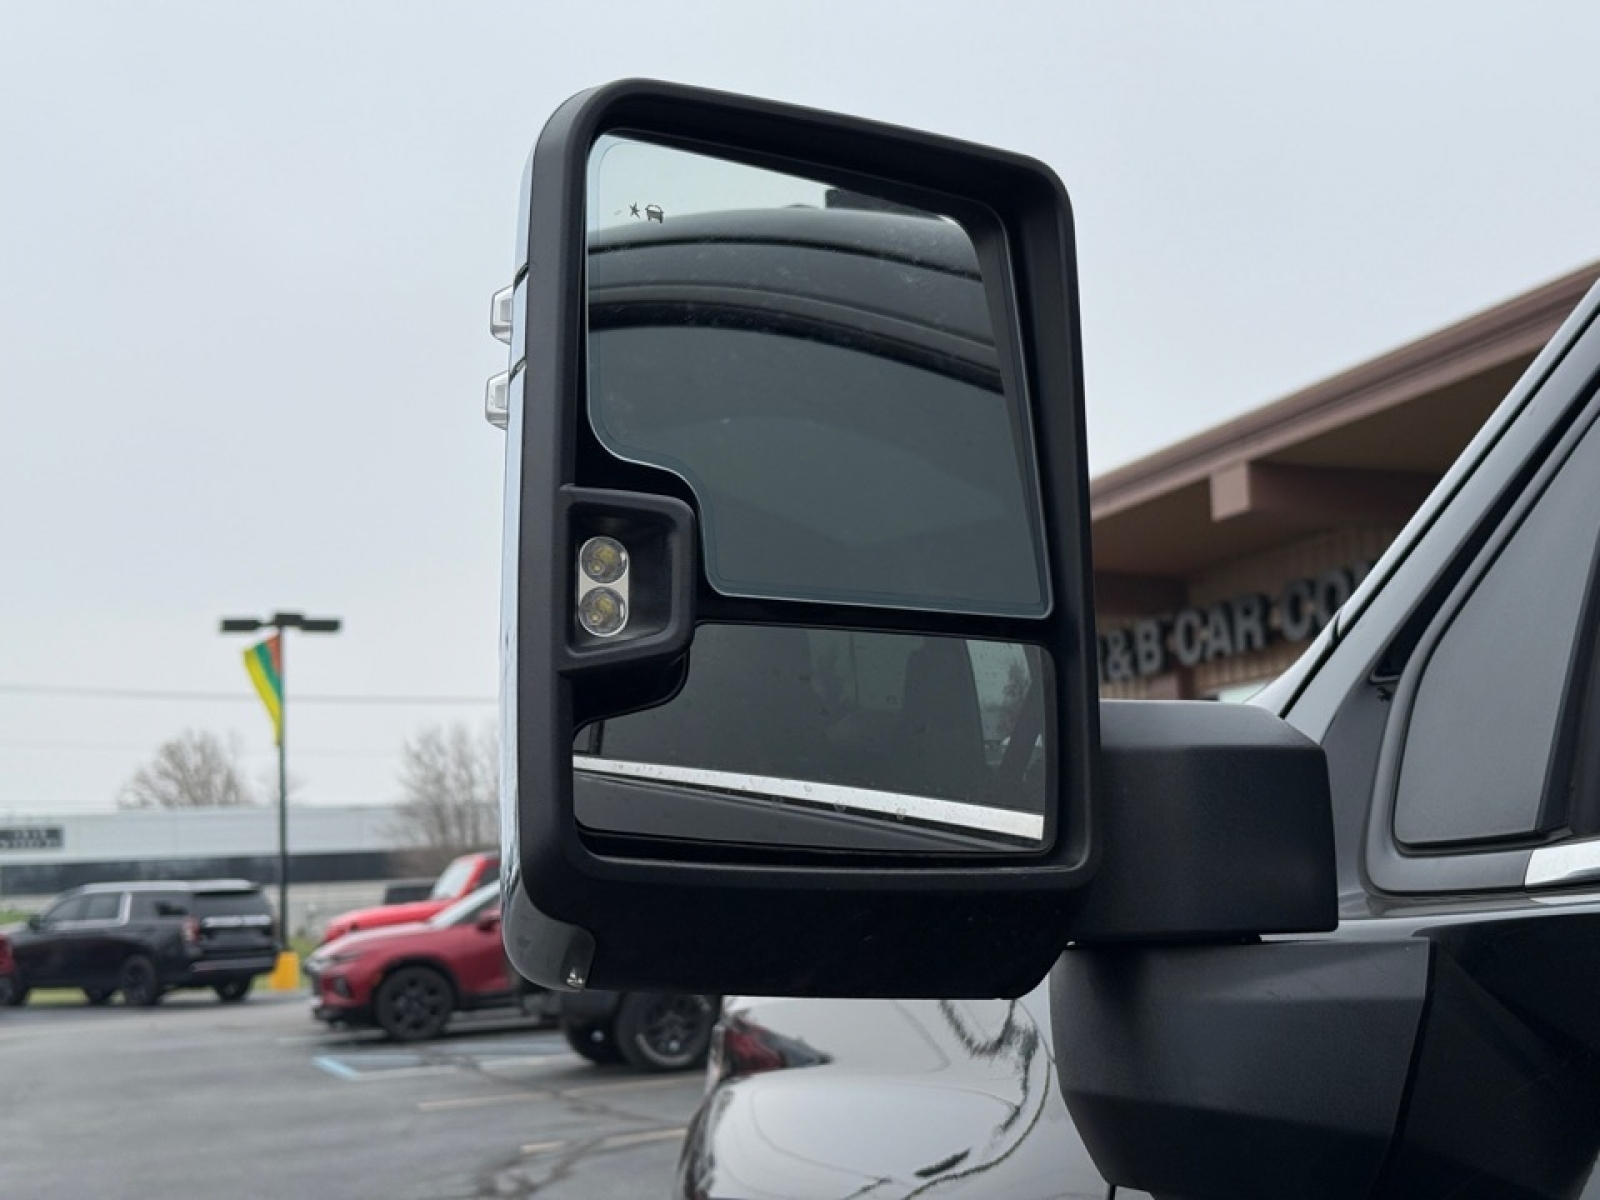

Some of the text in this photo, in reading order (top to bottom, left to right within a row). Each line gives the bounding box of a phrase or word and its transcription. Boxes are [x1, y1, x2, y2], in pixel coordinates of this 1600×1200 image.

[1098, 562, 1369, 682] &B CAR CO
